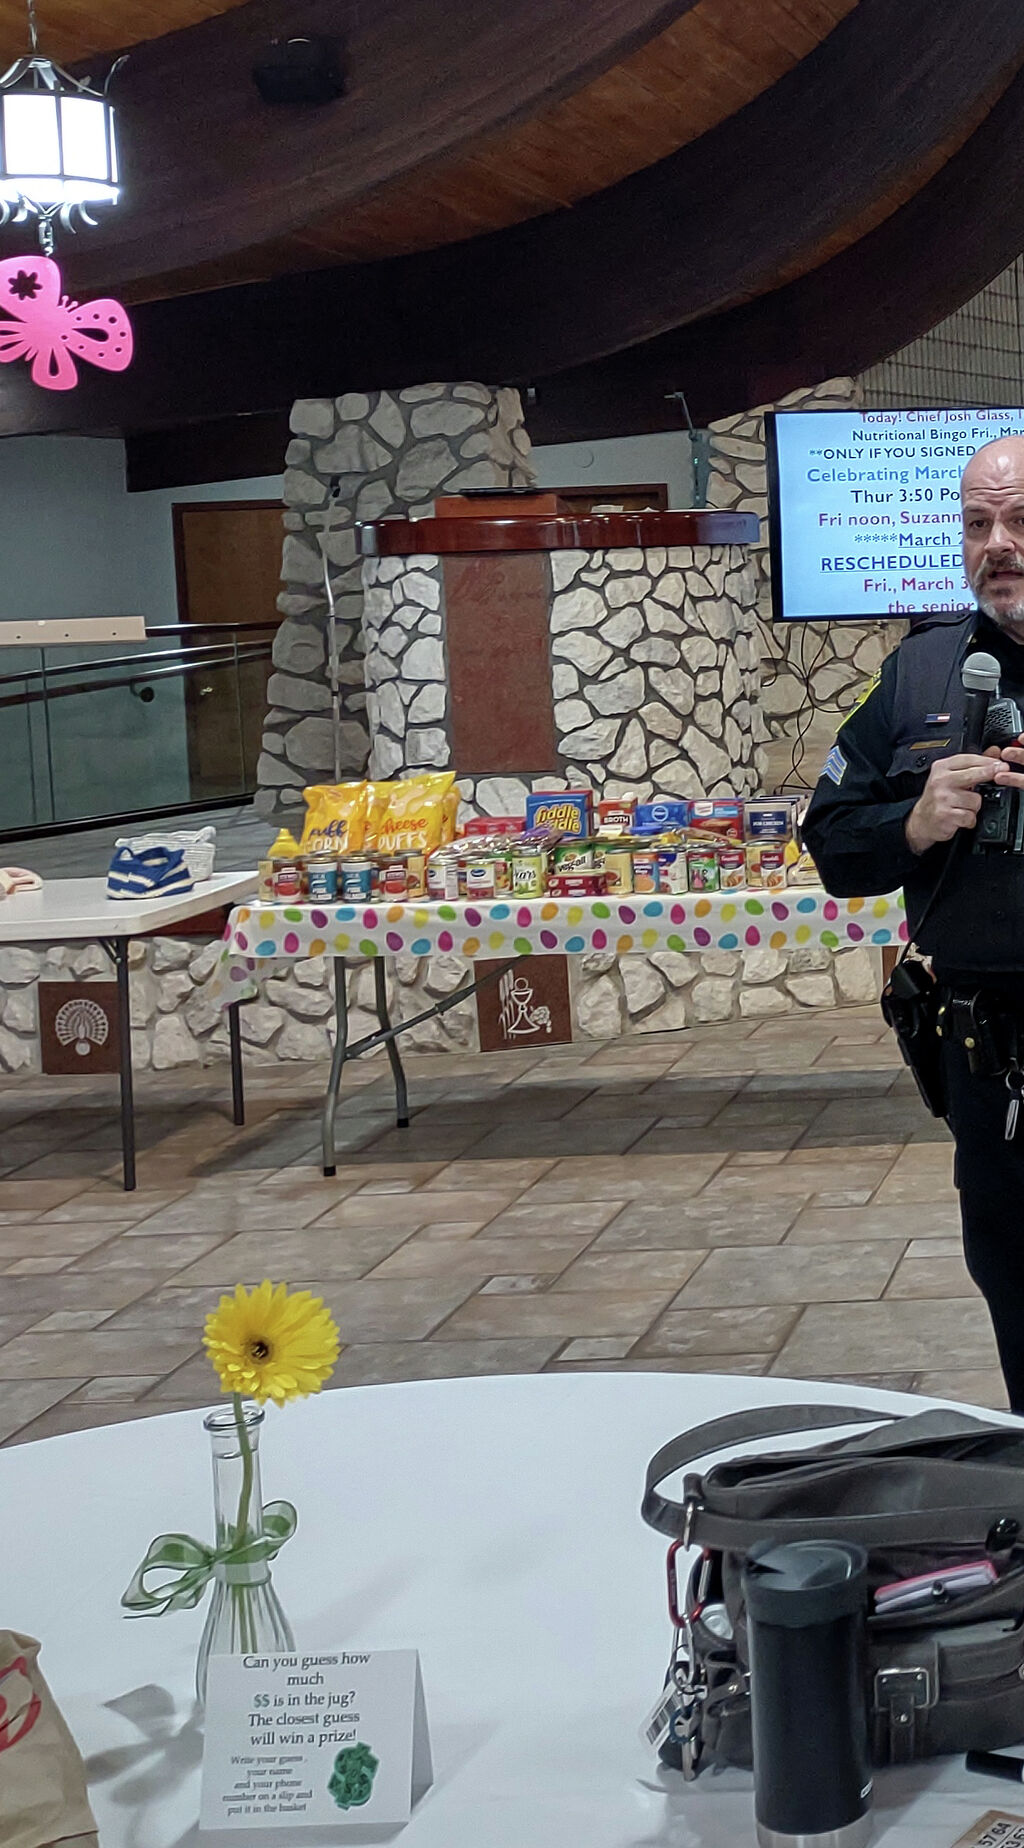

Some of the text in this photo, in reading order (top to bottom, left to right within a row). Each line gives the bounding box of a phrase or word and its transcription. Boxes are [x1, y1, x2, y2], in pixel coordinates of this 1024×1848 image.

[860, 411, 902, 425] Today!
[906, 411, 942, 422] Chief
[944, 410, 971, 424] Josh
[976, 409, 1014, 421] Glass,
[852, 429, 926, 441] Nutritional
[930, 428, 967, 442] Bingo
[971, 427, 997, 440] Fri.,
[869, 447, 882, 459] IF
[885, 447, 915, 458] YOU
[920, 445, 976, 457] SIGNED
[807, 467, 910, 484] Celebrating
[915, 464, 962, 480] March
[850, 489, 893, 503] Thur
[899, 488, 933, 503] 3:50
[818, 512, 842, 526] Fri
[848, 514, 896, 527] noon,
[900, 511, 962, 524] Suzann
[821, 553, 963, 571] RESCHEDULED
[864, 578, 897, 593] Fri.,
[901, 576, 954, 591] March
[888, 598, 975, 614] the senior
[536, 804, 579, 824] fiddle
[603, 815, 629, 824] BROTH
[378, 830, 428, 851] PUFFS
[243, 1652, 371, 1671] Can you guess how
[287, 1672, 324, 1686] much
[273, 1694, 284, 1707] is
[287, 1693, 301, 1706] in
[304, 1692, 326, 1706] the
[327, 1691, 356, 1708] jug?
[248, 1711, 360, 1727] The closest guess
[250, 1729, 357, 1747] will win a prize!
